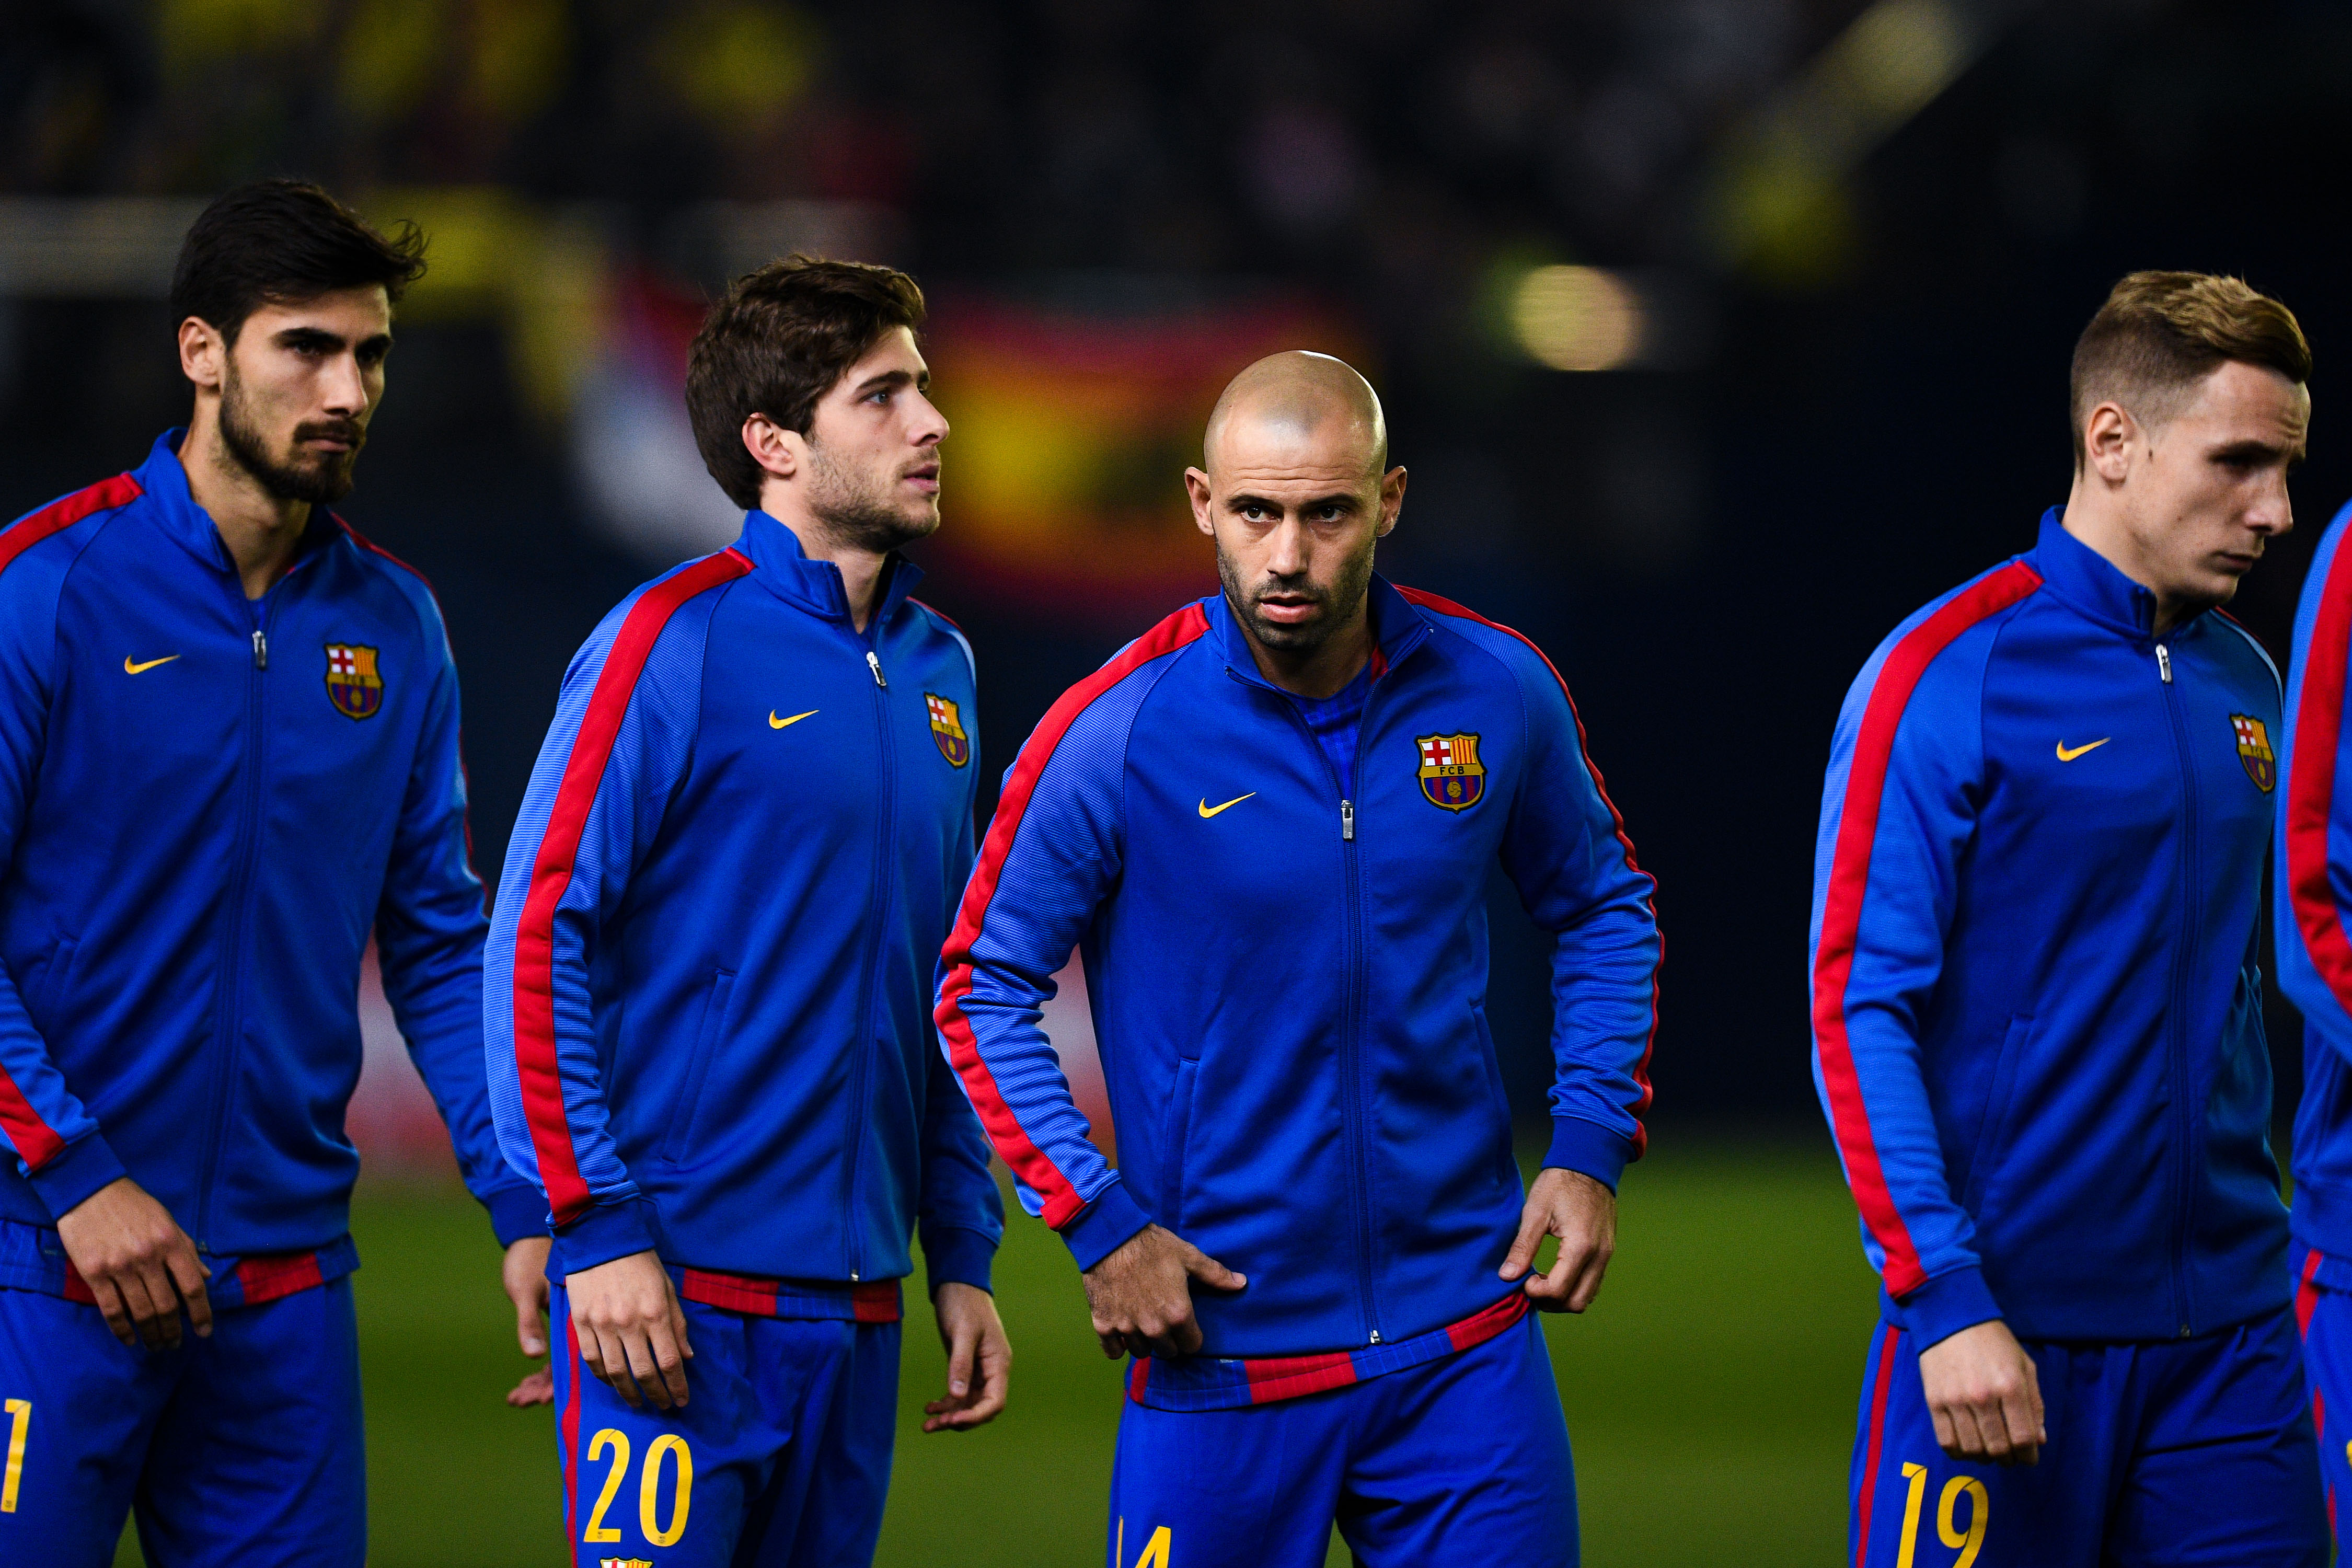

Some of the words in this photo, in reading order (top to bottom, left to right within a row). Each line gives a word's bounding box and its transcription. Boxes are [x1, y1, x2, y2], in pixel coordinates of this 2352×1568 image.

[1439, 766, 1465, 776] FCB
[1, 1398, 31, 1513] 1
[583, 1428, 693, 1547] 20
[1896, 1461, 1989, 1568] 19
